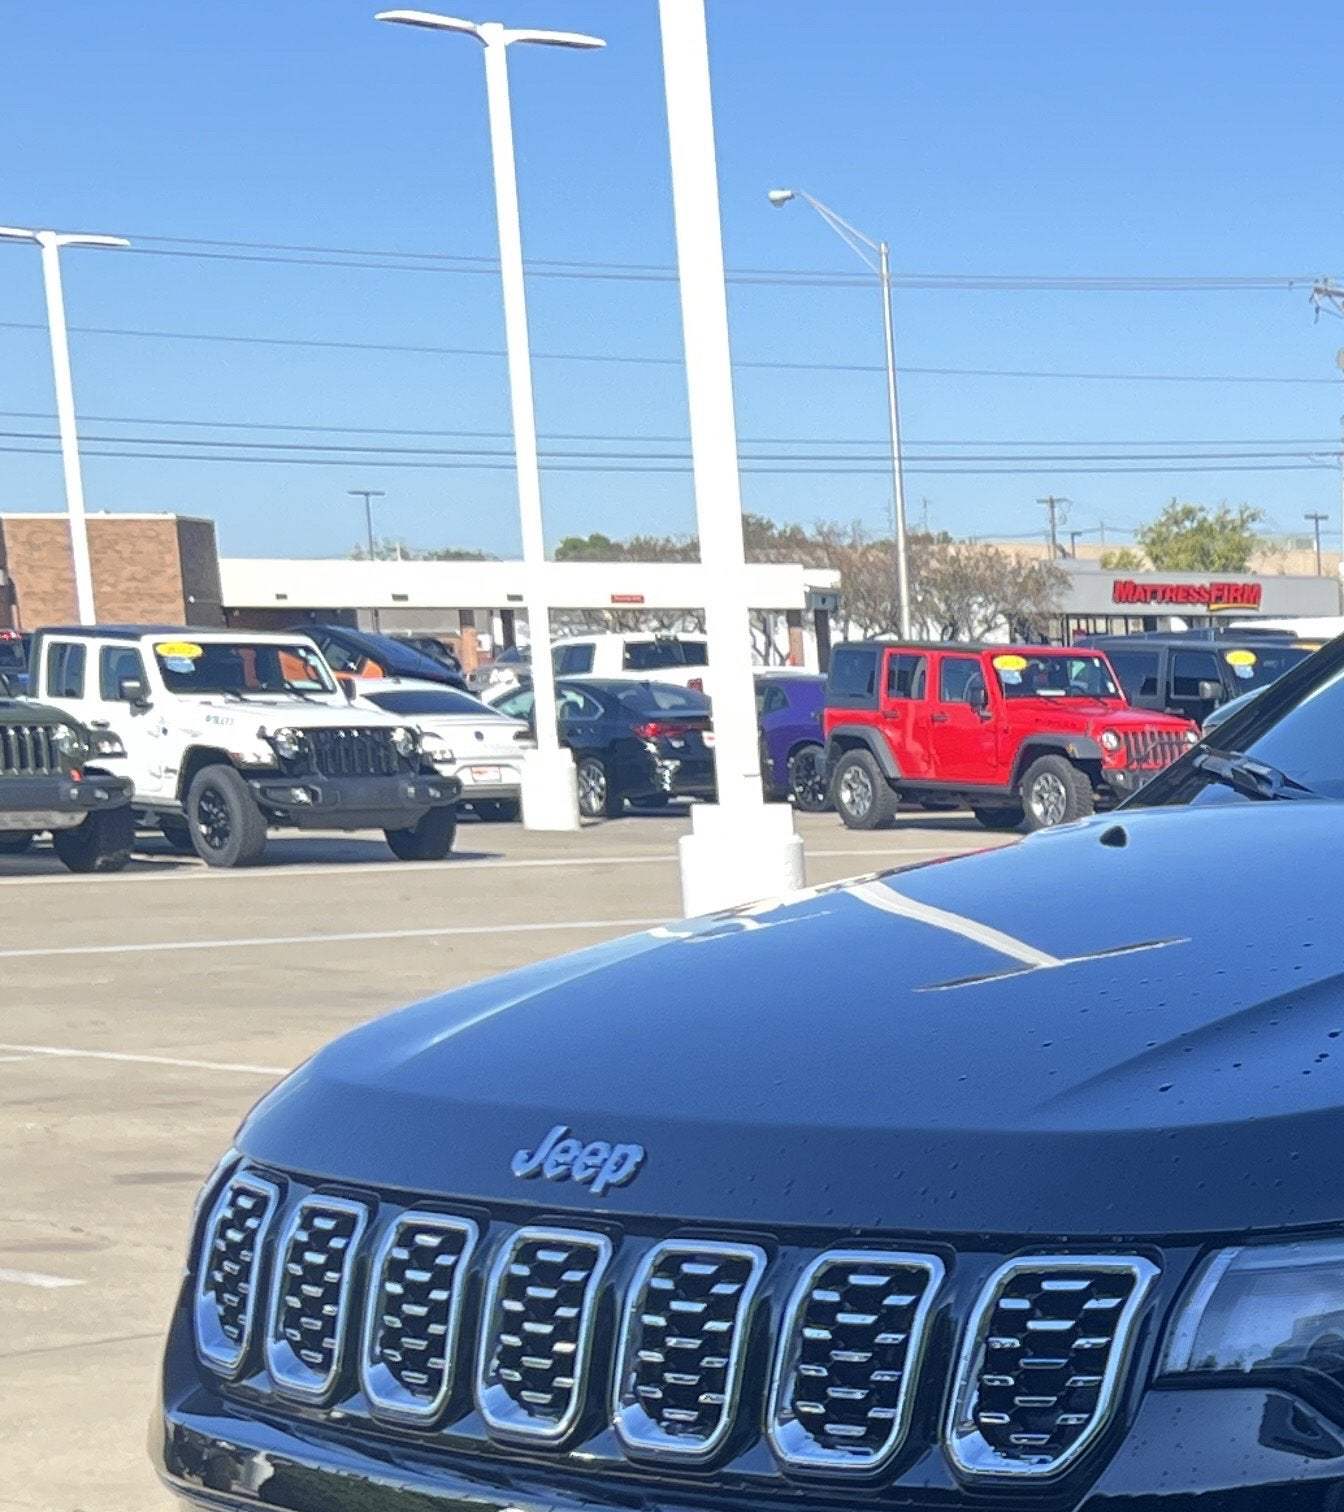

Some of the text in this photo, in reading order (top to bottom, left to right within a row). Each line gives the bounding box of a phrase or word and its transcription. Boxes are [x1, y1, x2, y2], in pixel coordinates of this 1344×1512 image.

[1113, 580, 1263, 606] MATTRESS FIRM
[511, 1124, 649, 1198] Jeep
